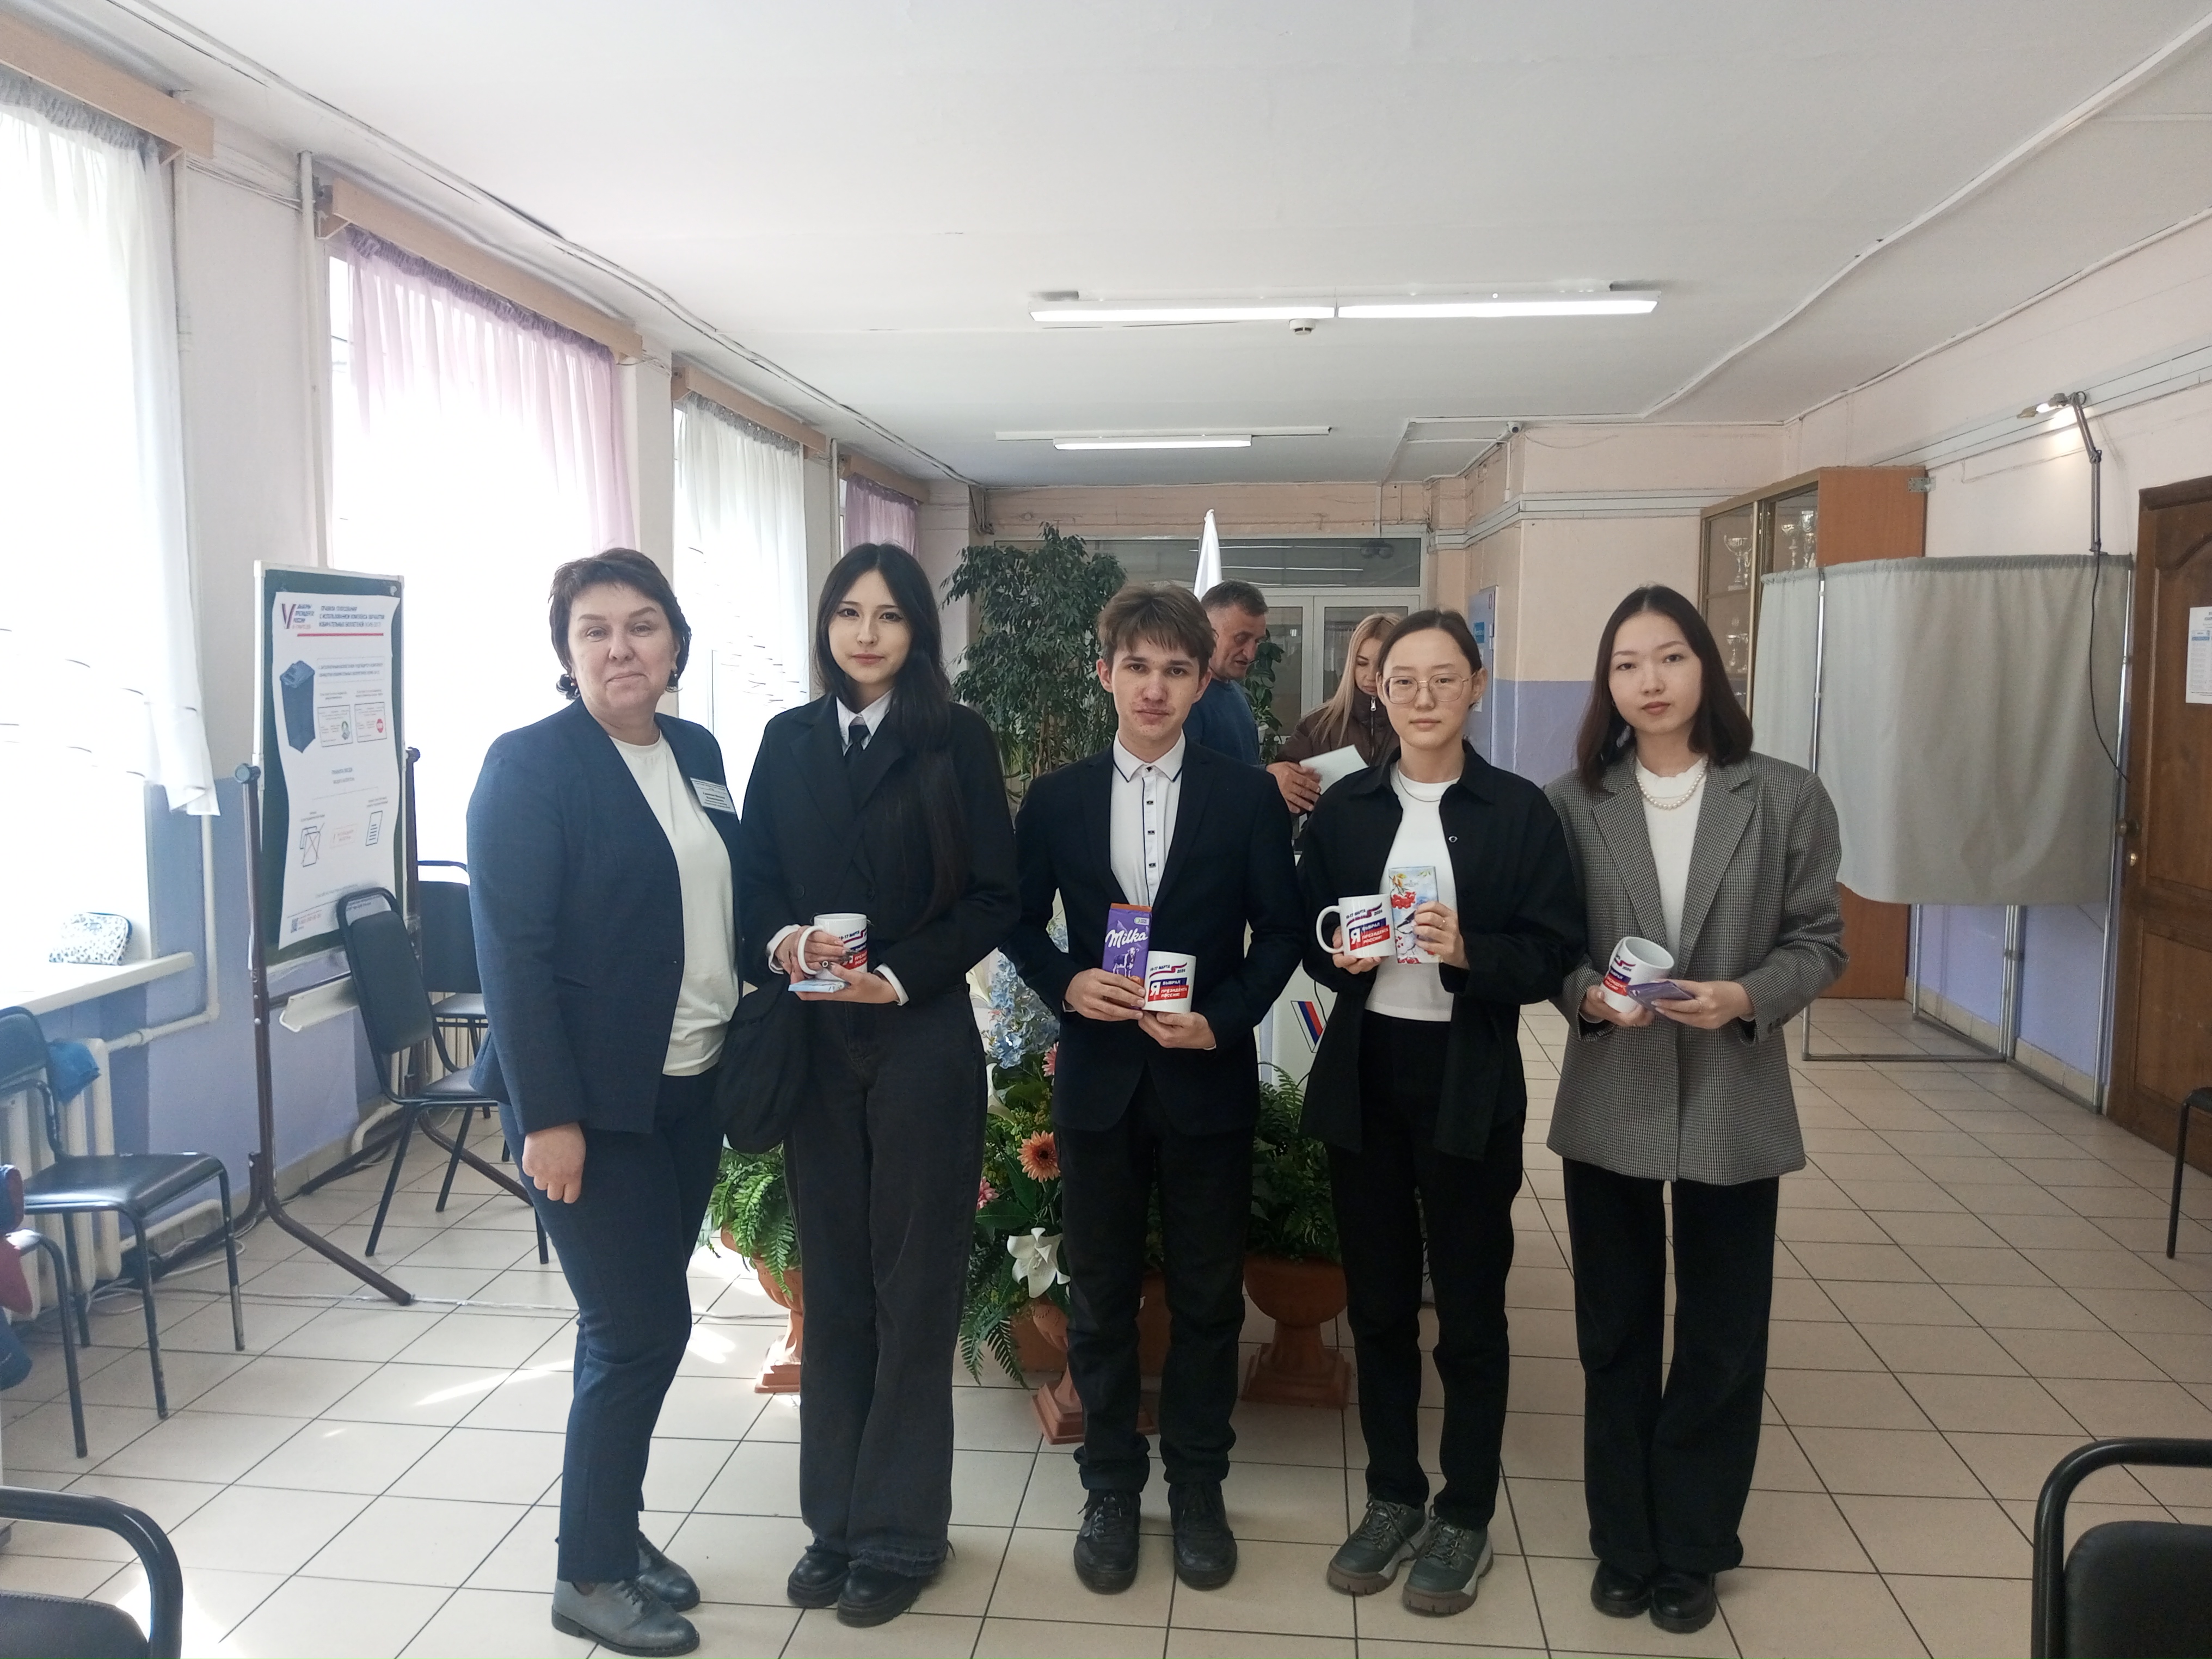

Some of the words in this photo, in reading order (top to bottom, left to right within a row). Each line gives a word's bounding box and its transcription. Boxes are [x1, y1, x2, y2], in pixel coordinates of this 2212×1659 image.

[1105, 928, 1148, 948] Milka
[1350, 928, 1361, 945] Я
[1362, 927, 1388, 939] ПРЕЗИДЕНТА
[1149, 981, 1162, 997] Я
